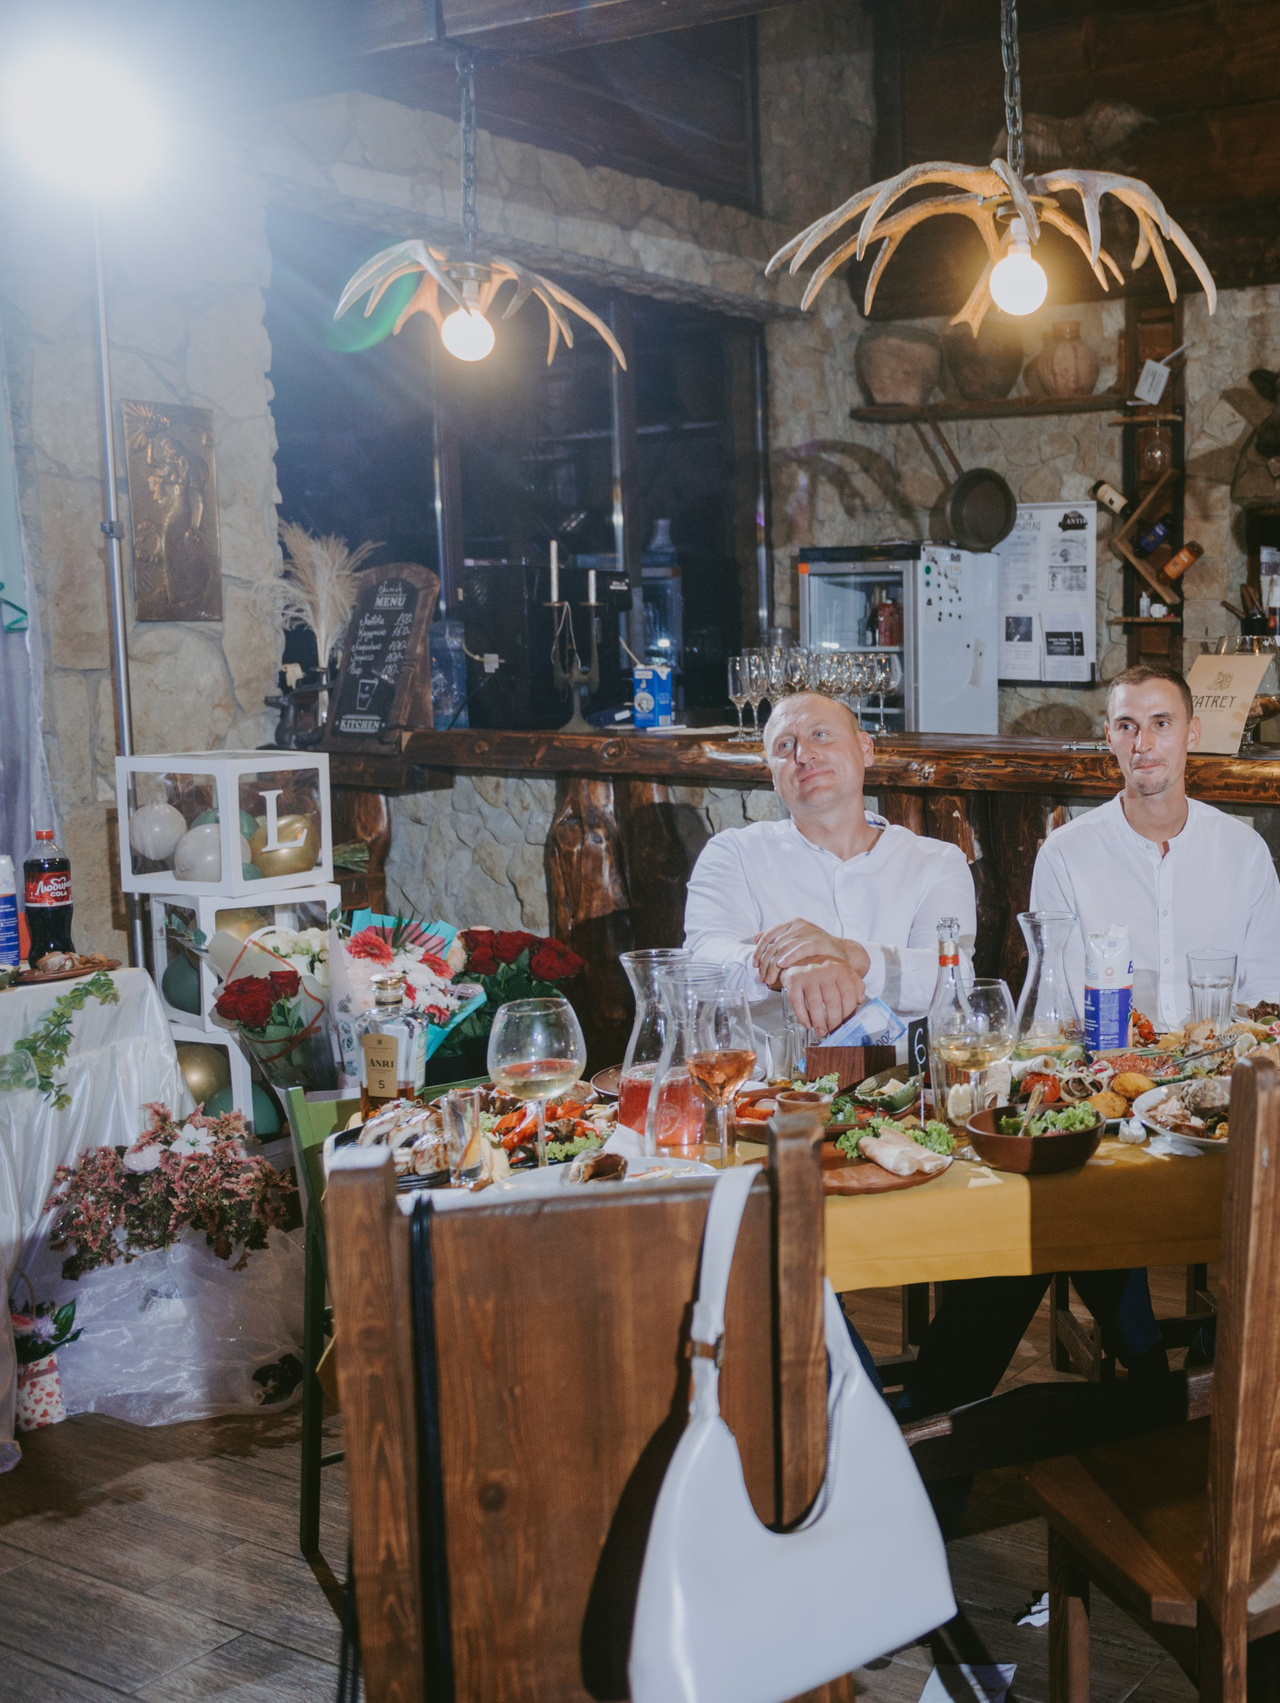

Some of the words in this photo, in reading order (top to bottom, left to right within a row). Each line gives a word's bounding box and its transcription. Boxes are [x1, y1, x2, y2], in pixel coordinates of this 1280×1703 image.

[373, 596, 406, 607] MENU
[339, 719, 381, 730] KITCHEN
[259, 789, 307, 853] L
[871, 1030, 894, 1047] 200
[914, 1028, 926, 1064] 6
[369, 1059, 395, 1069] ANRI
[378, 1080, 386, 1090] 5
